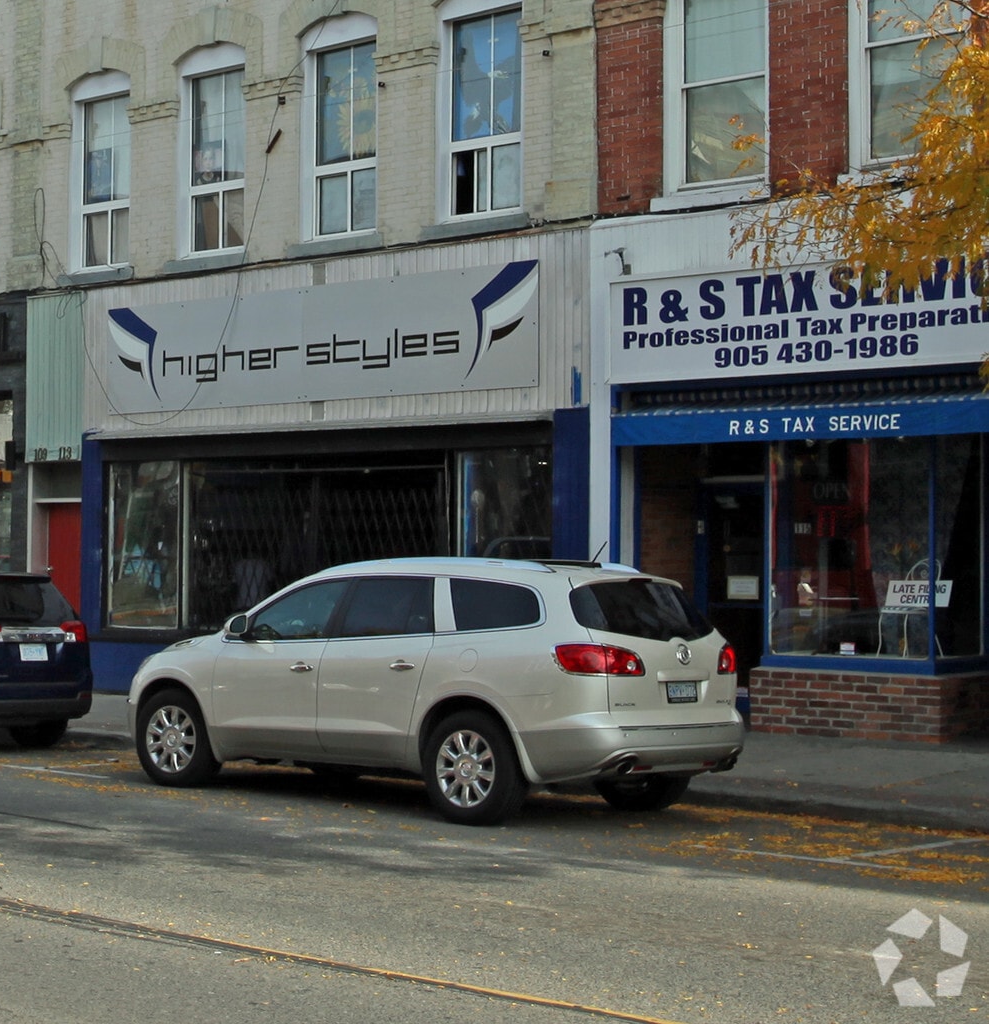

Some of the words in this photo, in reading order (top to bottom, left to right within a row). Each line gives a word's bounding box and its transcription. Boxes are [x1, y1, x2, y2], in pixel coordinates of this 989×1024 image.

[622, 287, 648, 326] R
[659, 289, 688, 324] &
[699, 279, 725, 320] S
[735, 270, 818, 317] TAX
[623, 319, 789, 350] Professional
[799, 317, 843, 337] Tax
[163, 344, 299, 383] higher
[306, 328, 460, 370] styles
[714, 344, 768, 368] 905
[776, 334, 919, 364] 430-1986
[782, 416, 815, 433] TAX
[829, 413, 901, 432] SERVICE
[892, 584, 916, 594] LATE
